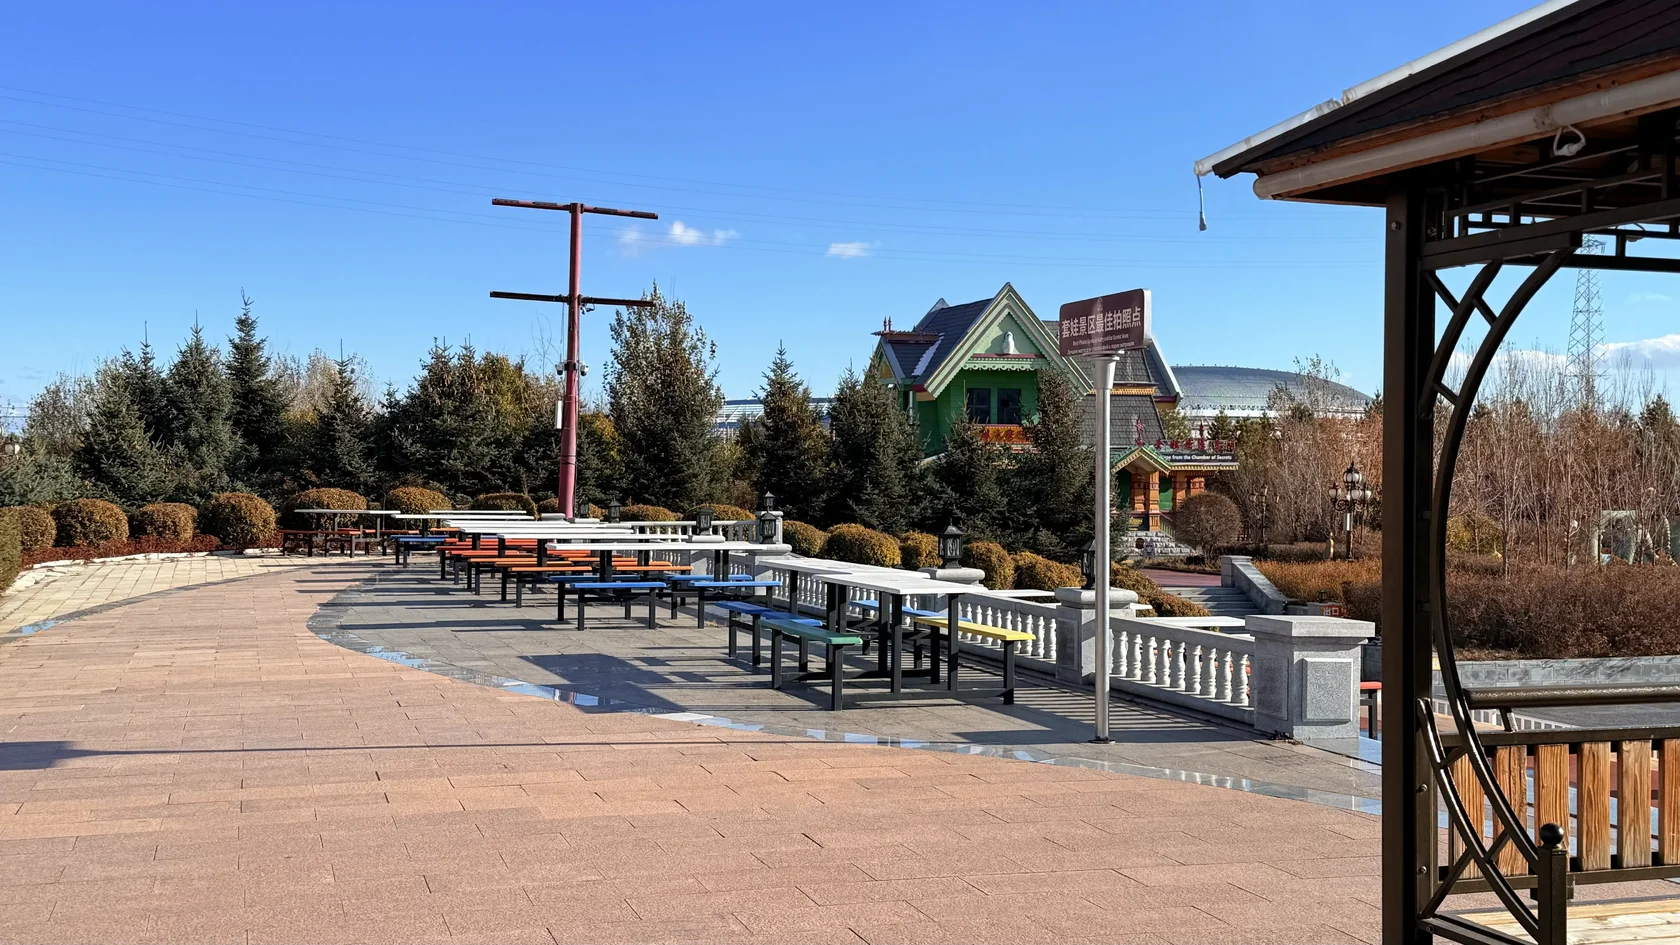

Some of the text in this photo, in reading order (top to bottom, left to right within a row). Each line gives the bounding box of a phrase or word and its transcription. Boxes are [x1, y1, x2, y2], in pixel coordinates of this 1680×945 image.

[1062, 306, 1142, 338] 套娃景区最佳拍照点
[1323, 606, 1339, 616] 出口
